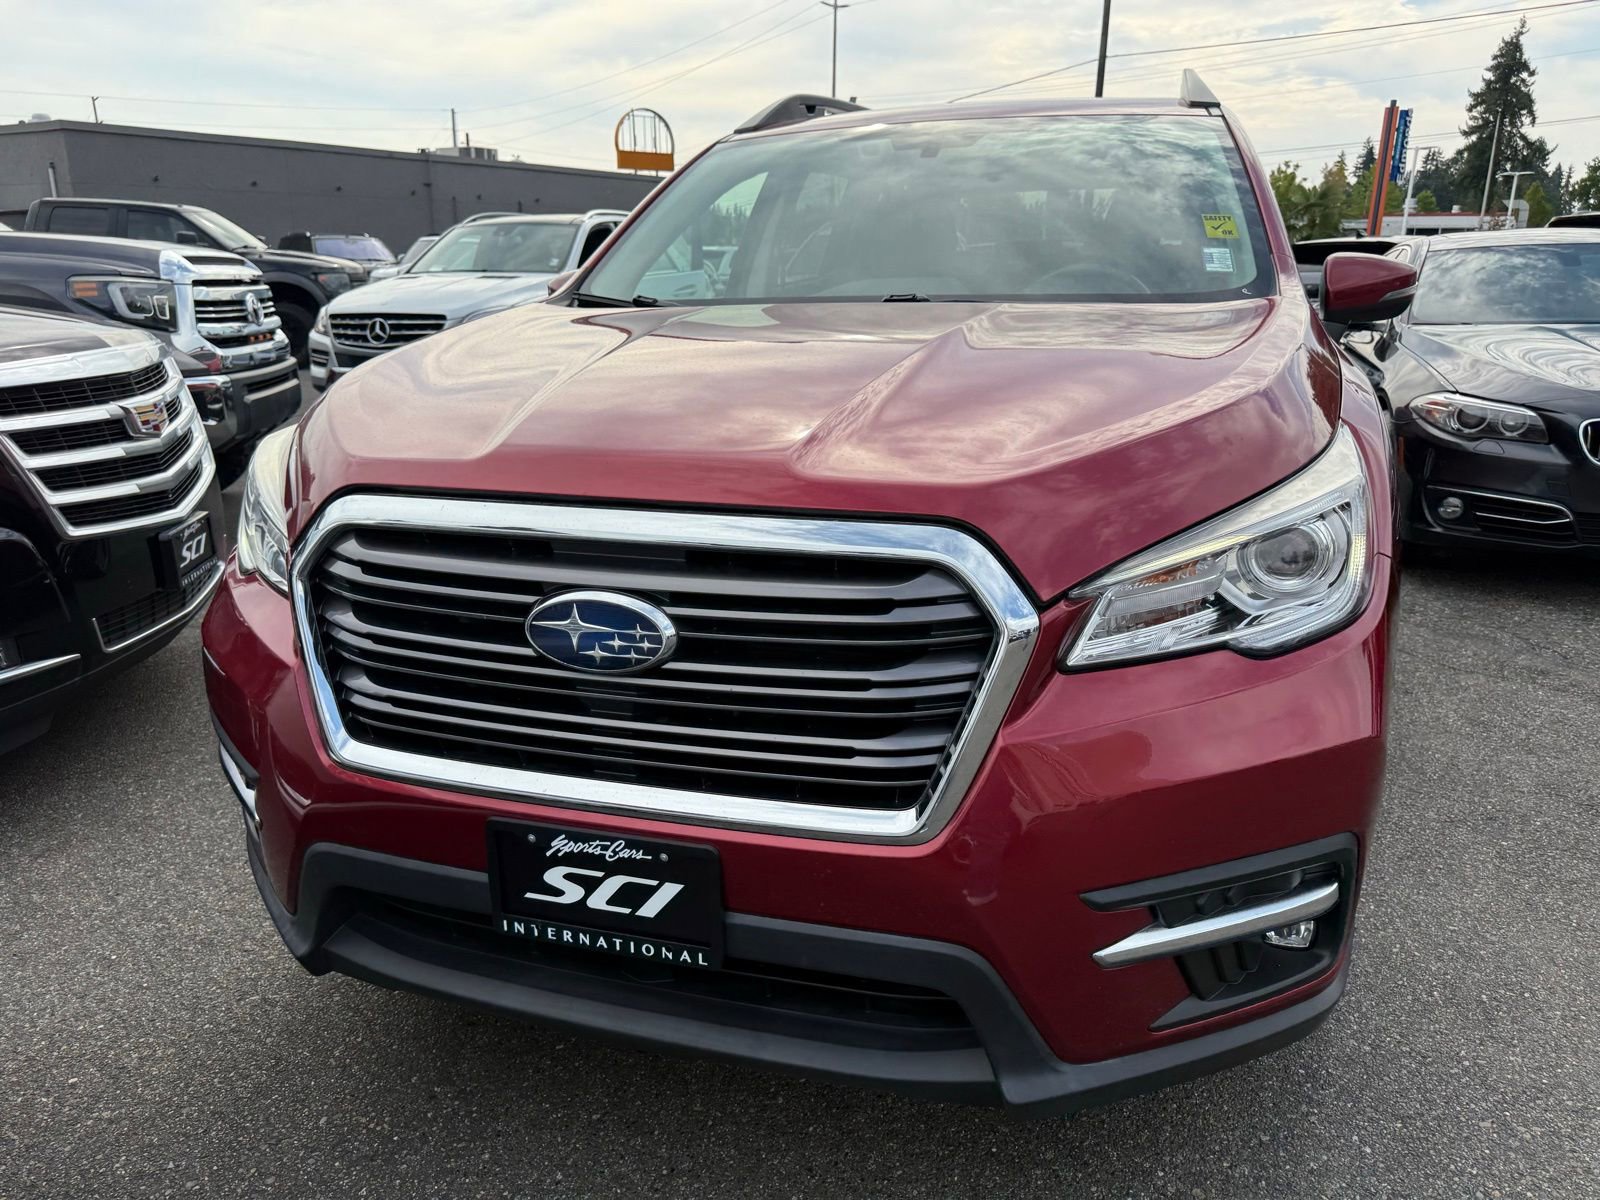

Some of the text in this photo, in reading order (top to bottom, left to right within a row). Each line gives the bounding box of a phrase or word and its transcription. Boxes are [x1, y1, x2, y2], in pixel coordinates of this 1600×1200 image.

[180, 532, 206, 568] SCI
[545, 834, 652, 861] Sports Cars
[523, 865, 685, 918] SCI
[503, 919, 708, 966] INTERNATIONAL
